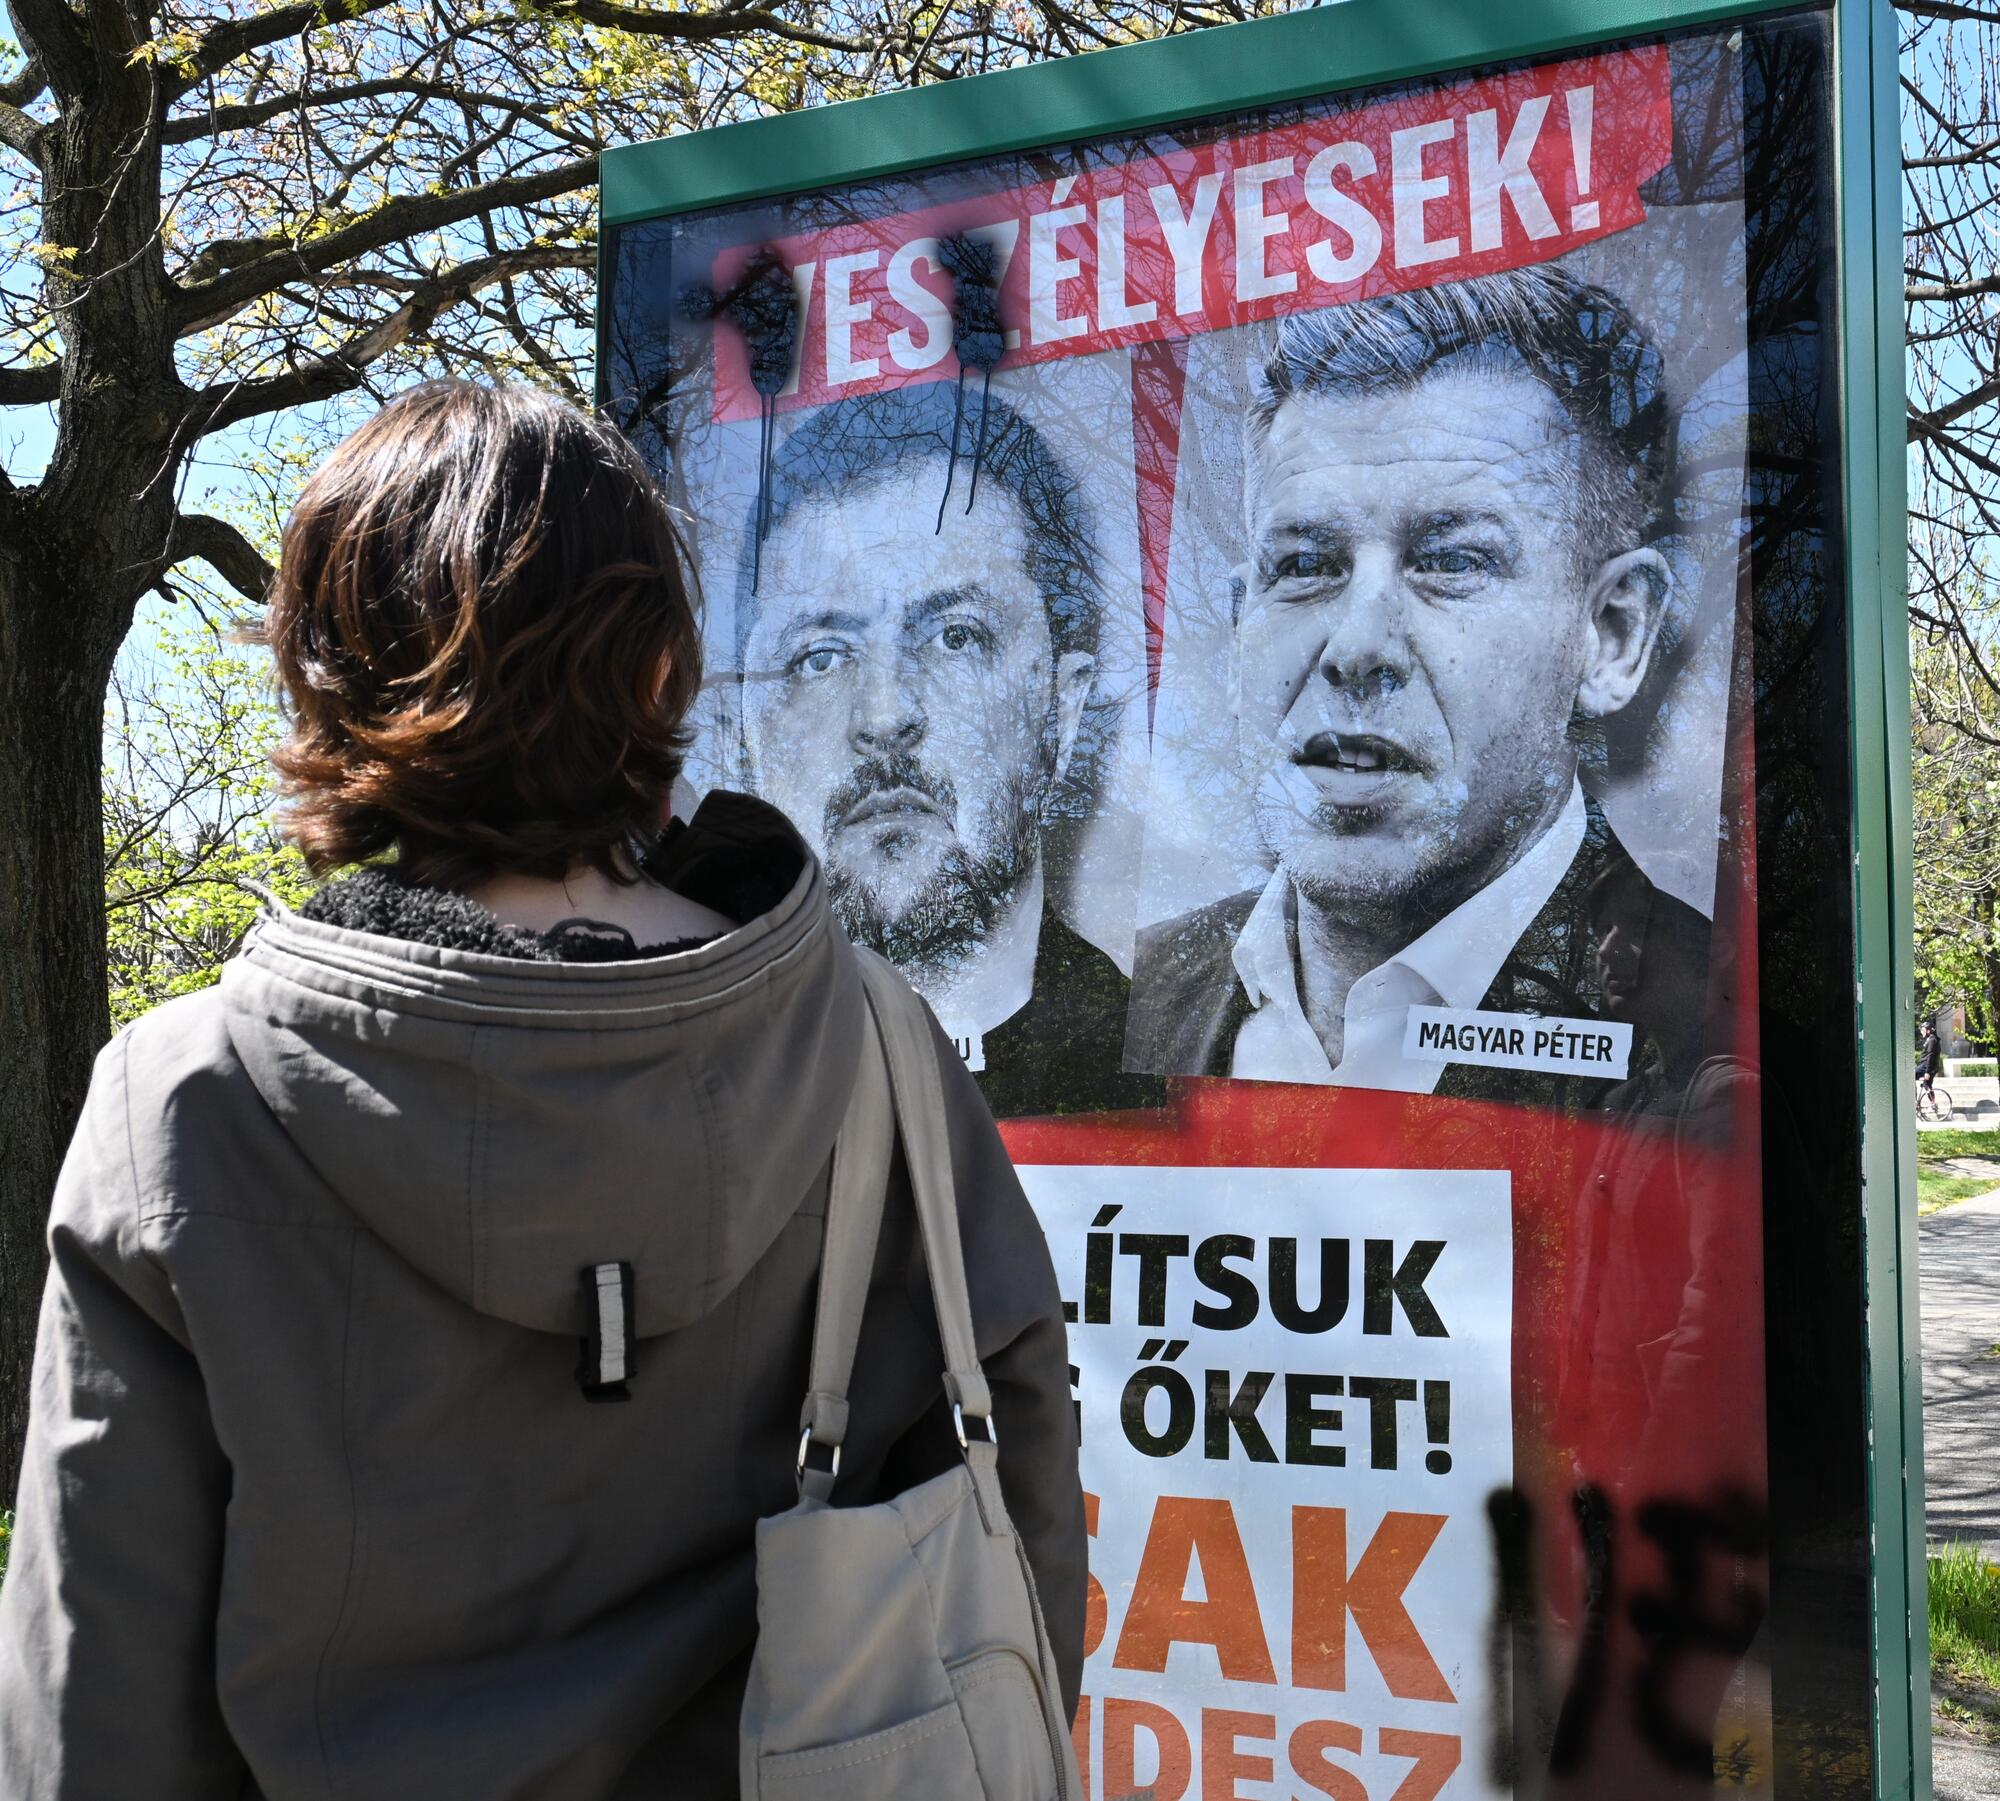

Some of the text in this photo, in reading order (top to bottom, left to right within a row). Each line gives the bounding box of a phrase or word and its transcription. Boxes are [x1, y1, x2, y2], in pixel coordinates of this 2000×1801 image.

[1418, 1021, 1613, 1063] MAGYAR PÉTER
[1060, 1203, 1451, 1339] ÍTSUK
[1119, 1338, 1453, 1476] ŐKET!
